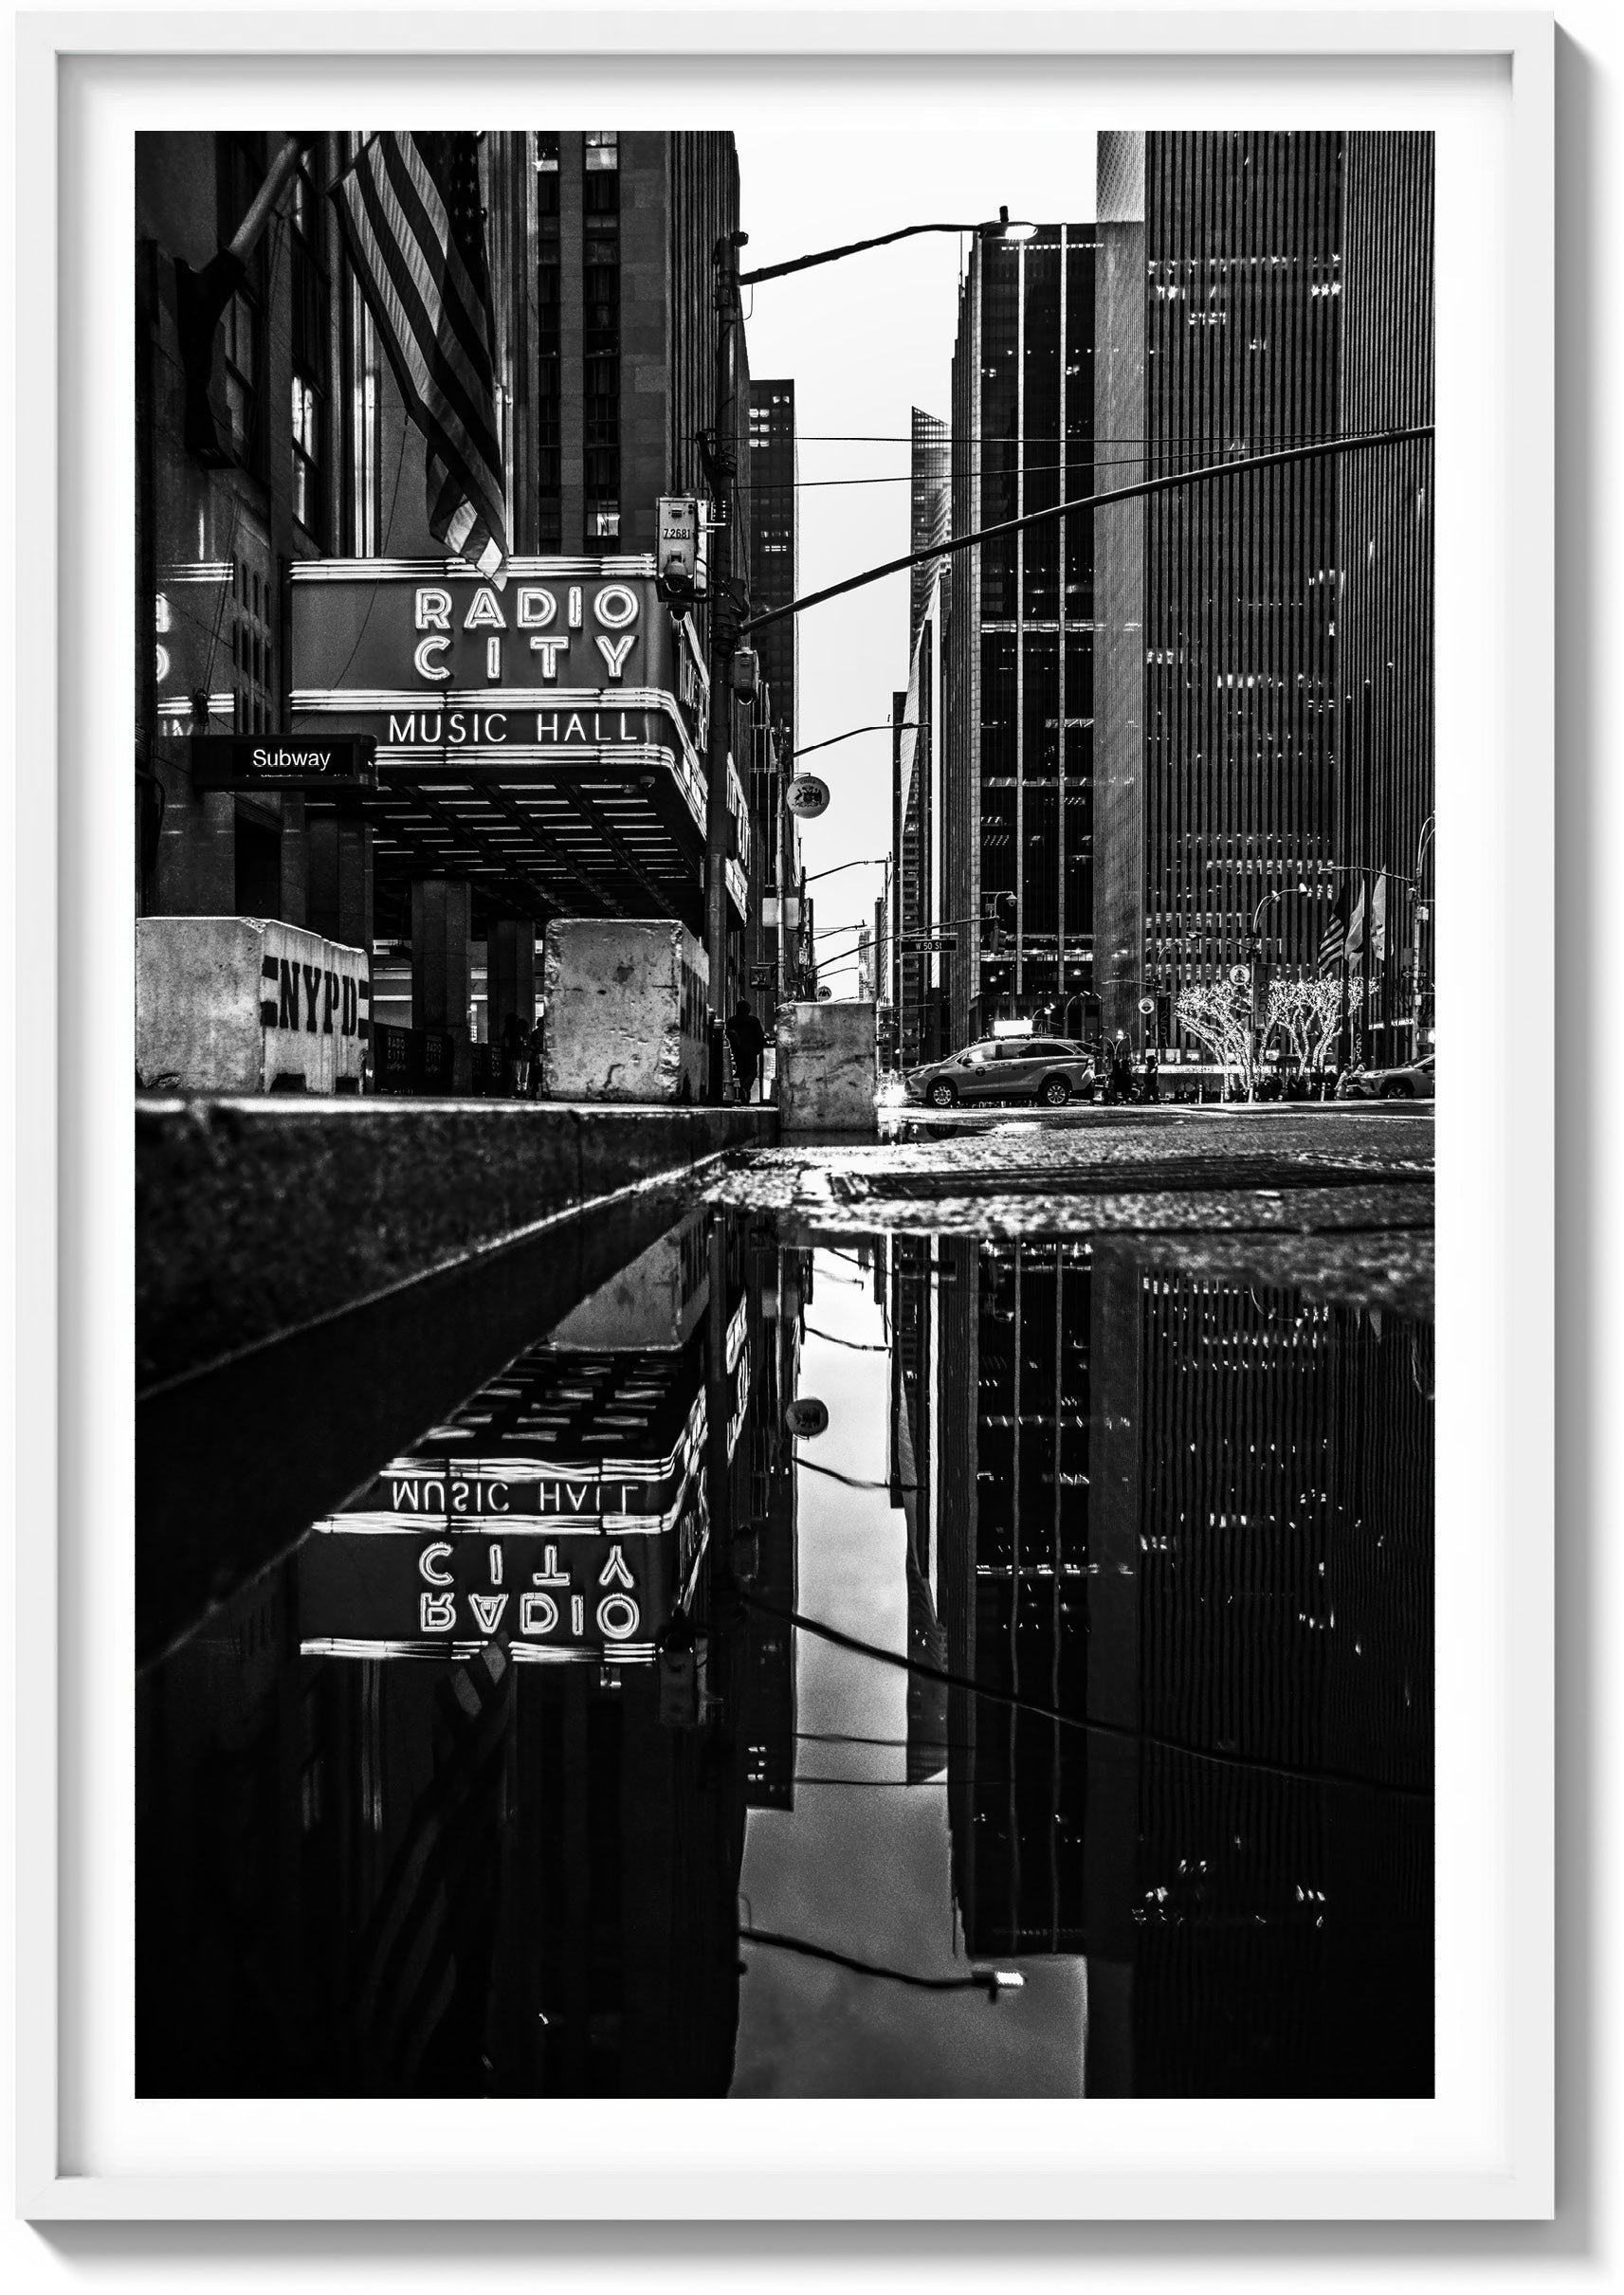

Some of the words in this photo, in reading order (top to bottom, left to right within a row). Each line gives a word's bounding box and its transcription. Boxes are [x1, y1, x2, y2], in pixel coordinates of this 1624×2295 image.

[415, 584, 639, 629] RADIO
[414, 635, 638, 681] CITY
[389, 713, 507, 742] MUSIC
[537, 712, 637, 742] HALL
[252, 748, 331, 771] Subway
[935, 941, 942, 950] St
[280, 958, 357, 1036] NYPD
